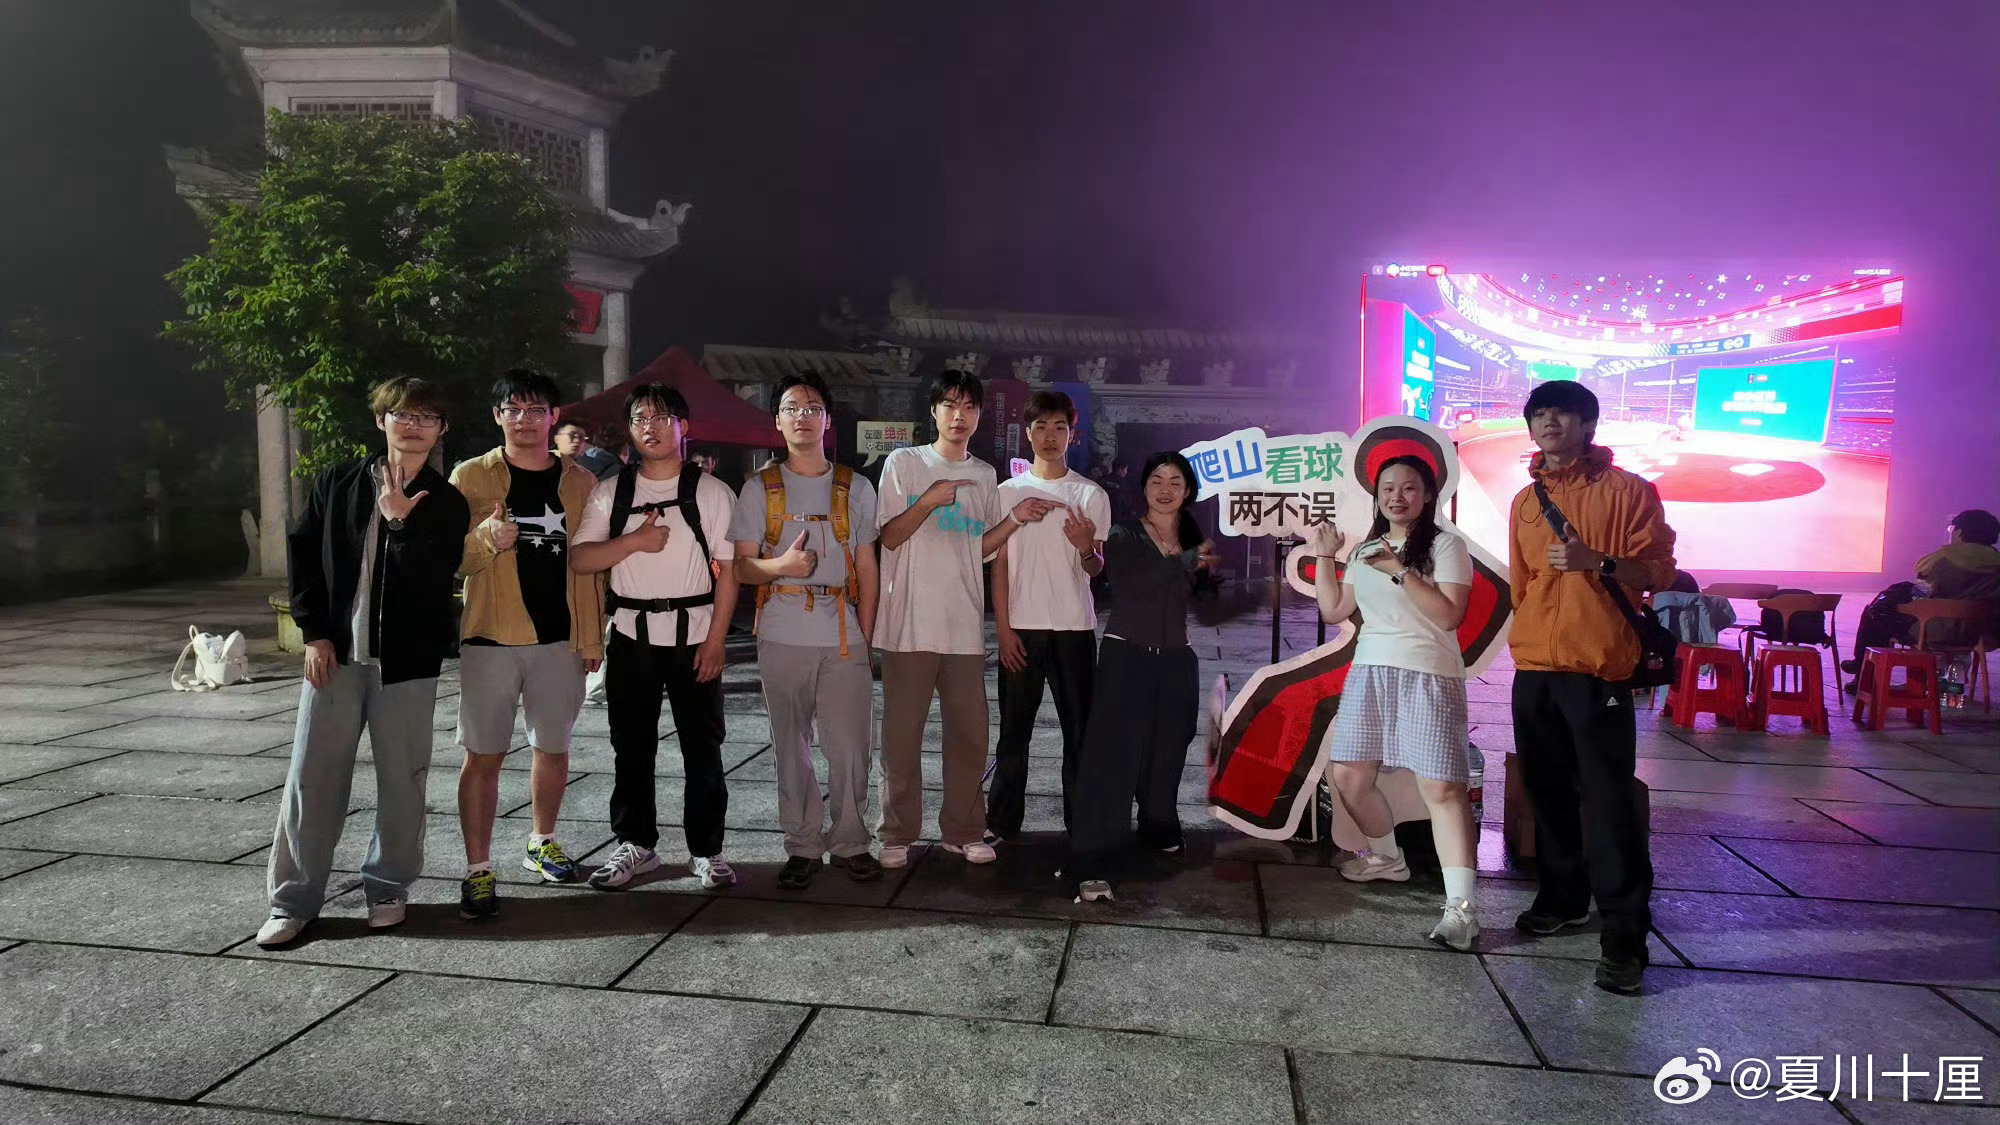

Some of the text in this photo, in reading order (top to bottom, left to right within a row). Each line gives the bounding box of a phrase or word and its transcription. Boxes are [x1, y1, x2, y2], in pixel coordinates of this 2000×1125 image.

[1188, 440, 1344, 489] 爬山看球
[1229, 491, 1336, 527] 两不误
